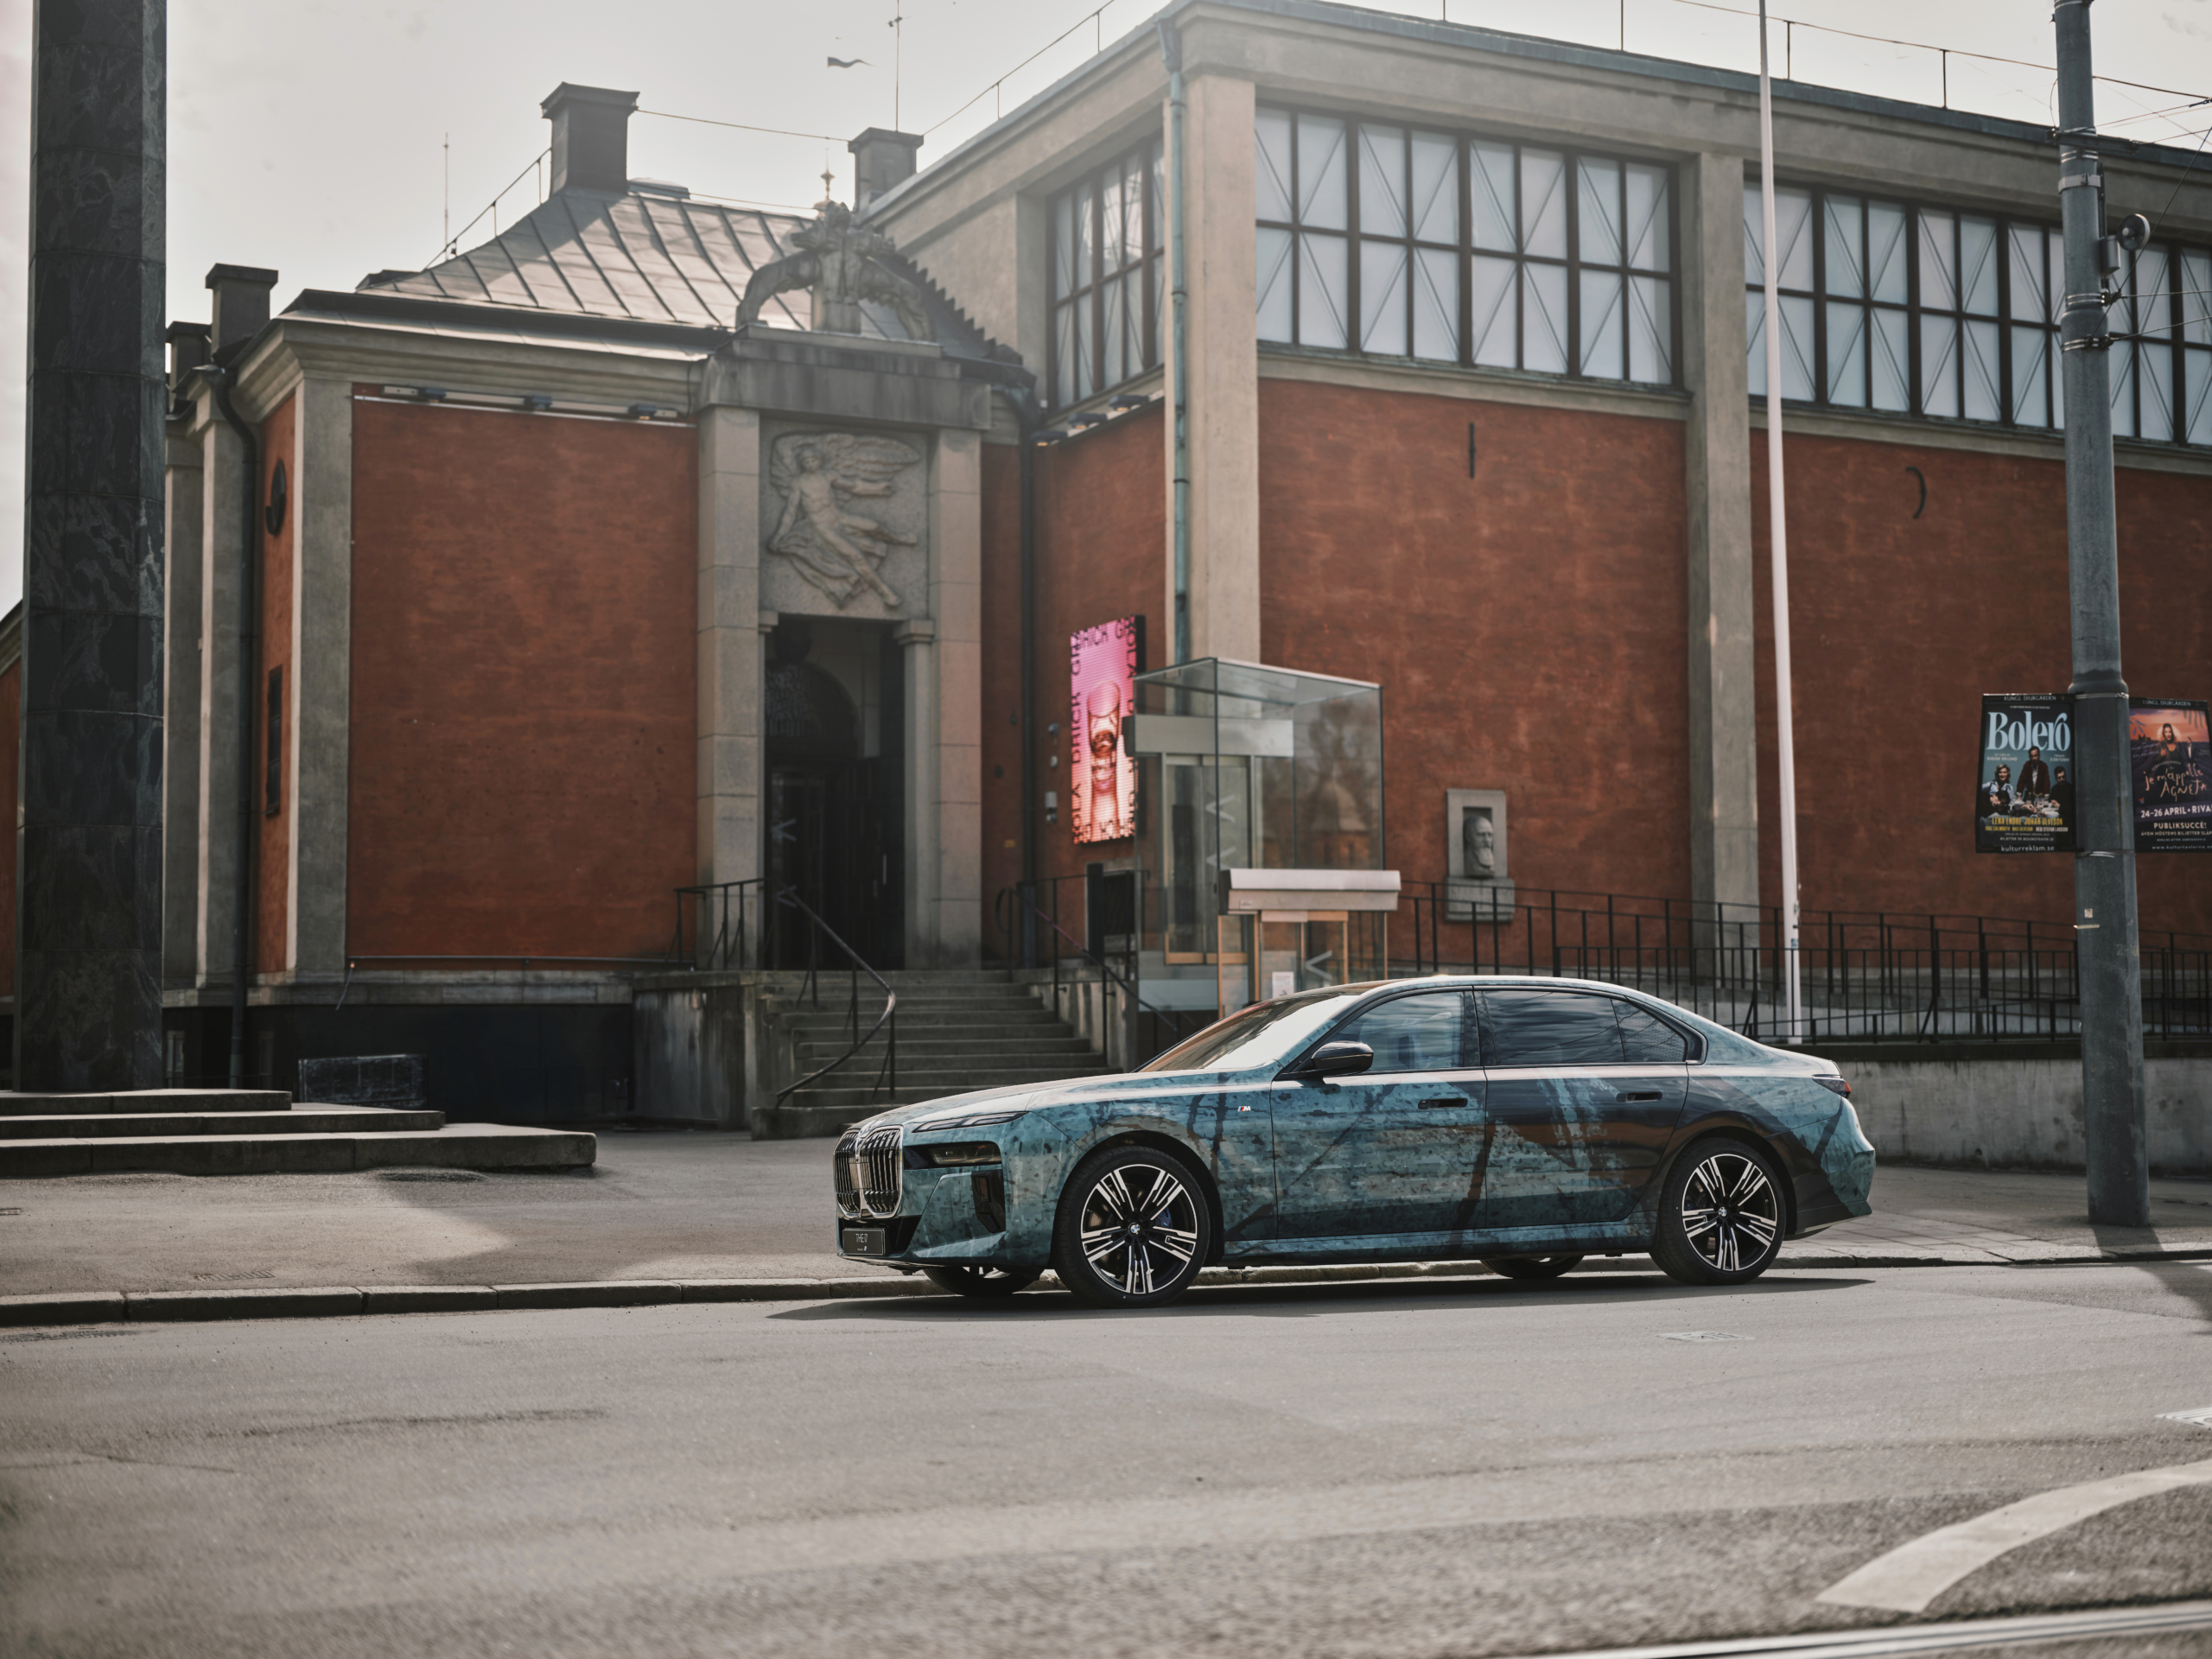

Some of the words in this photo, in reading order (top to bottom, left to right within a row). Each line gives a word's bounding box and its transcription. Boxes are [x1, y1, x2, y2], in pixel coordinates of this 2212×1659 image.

[1986, 710, 2071, 752] Bolero
[2140, 809, 2163, 818] 24-26
[2164, 806, 2187, 817] APRIL
[1992, 817, 2005, 825] LENA
